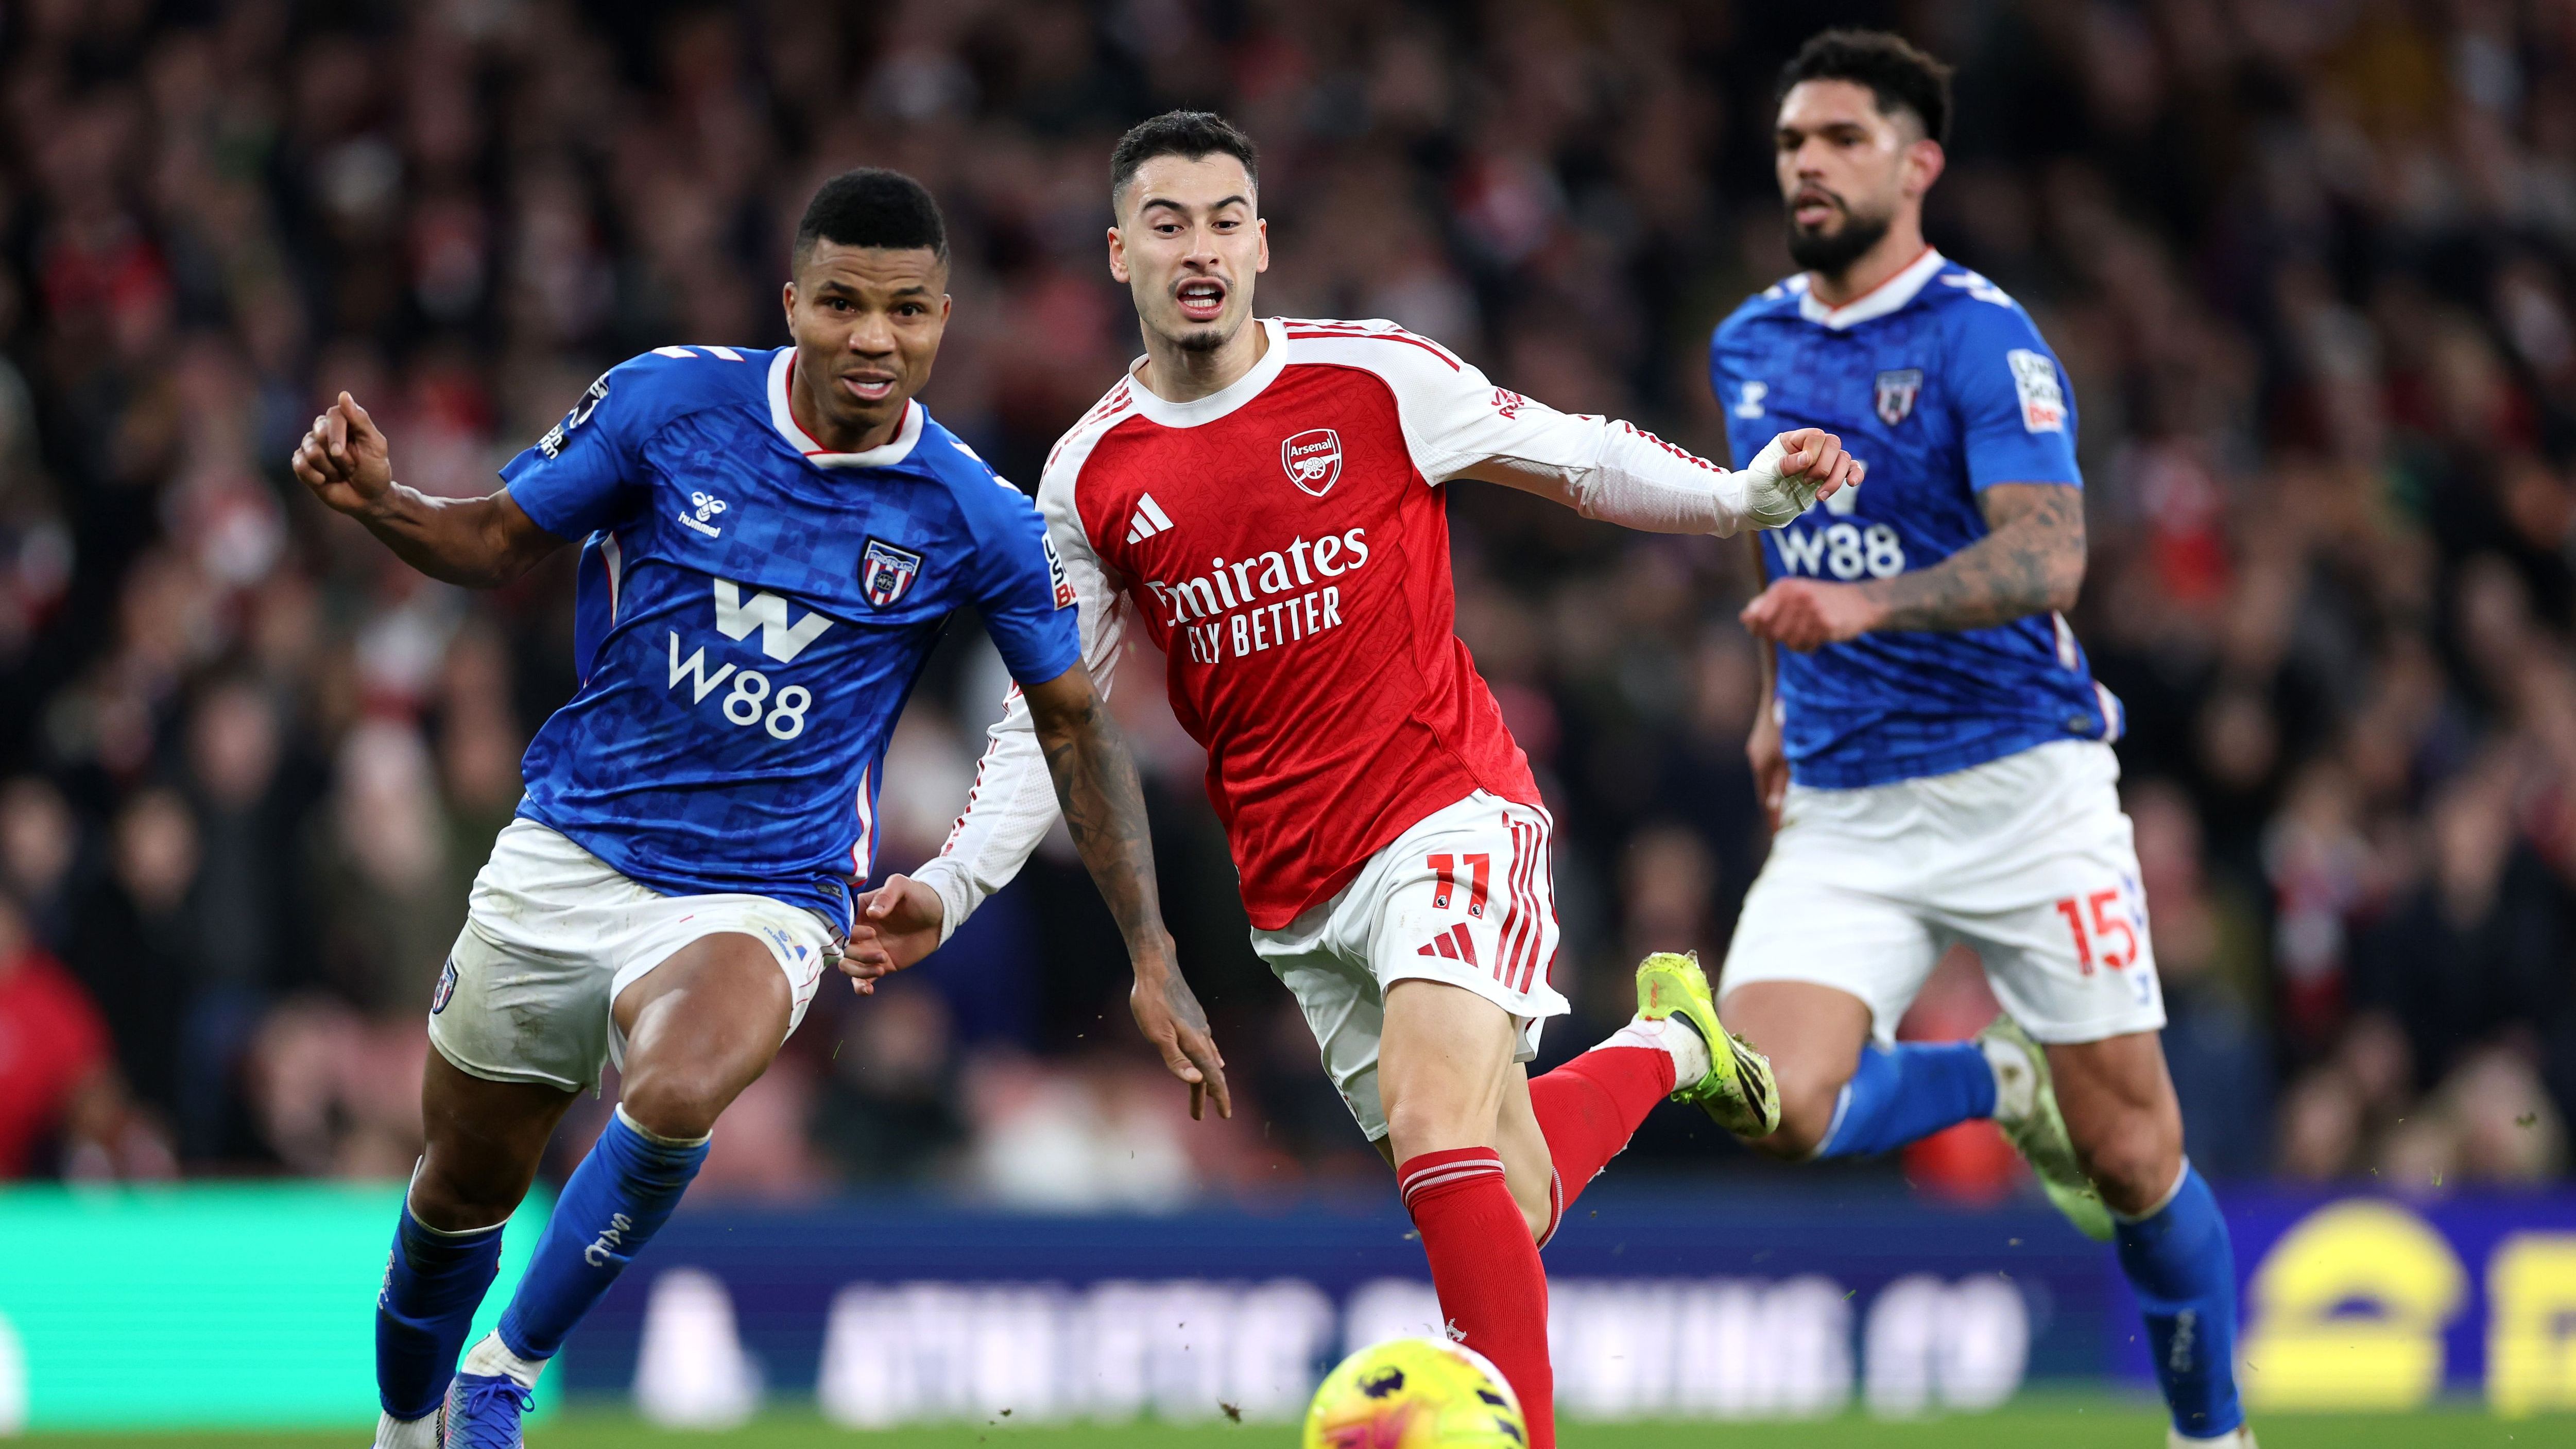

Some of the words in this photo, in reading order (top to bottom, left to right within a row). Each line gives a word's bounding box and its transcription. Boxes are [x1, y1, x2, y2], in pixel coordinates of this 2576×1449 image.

[1291, 438, 1332, 457] Arsenal
[678, 511, 721, 538] hummel
[1770, 523, 1905, 580] W88
[1187, 623, 1221, 664] FLY
[1231, 586, 1342, 658] BETTER
[669, 630, 812, 740] W88
[1426, 853, 1489, 920] 11
[2056, 887, 2137, 976] 15
